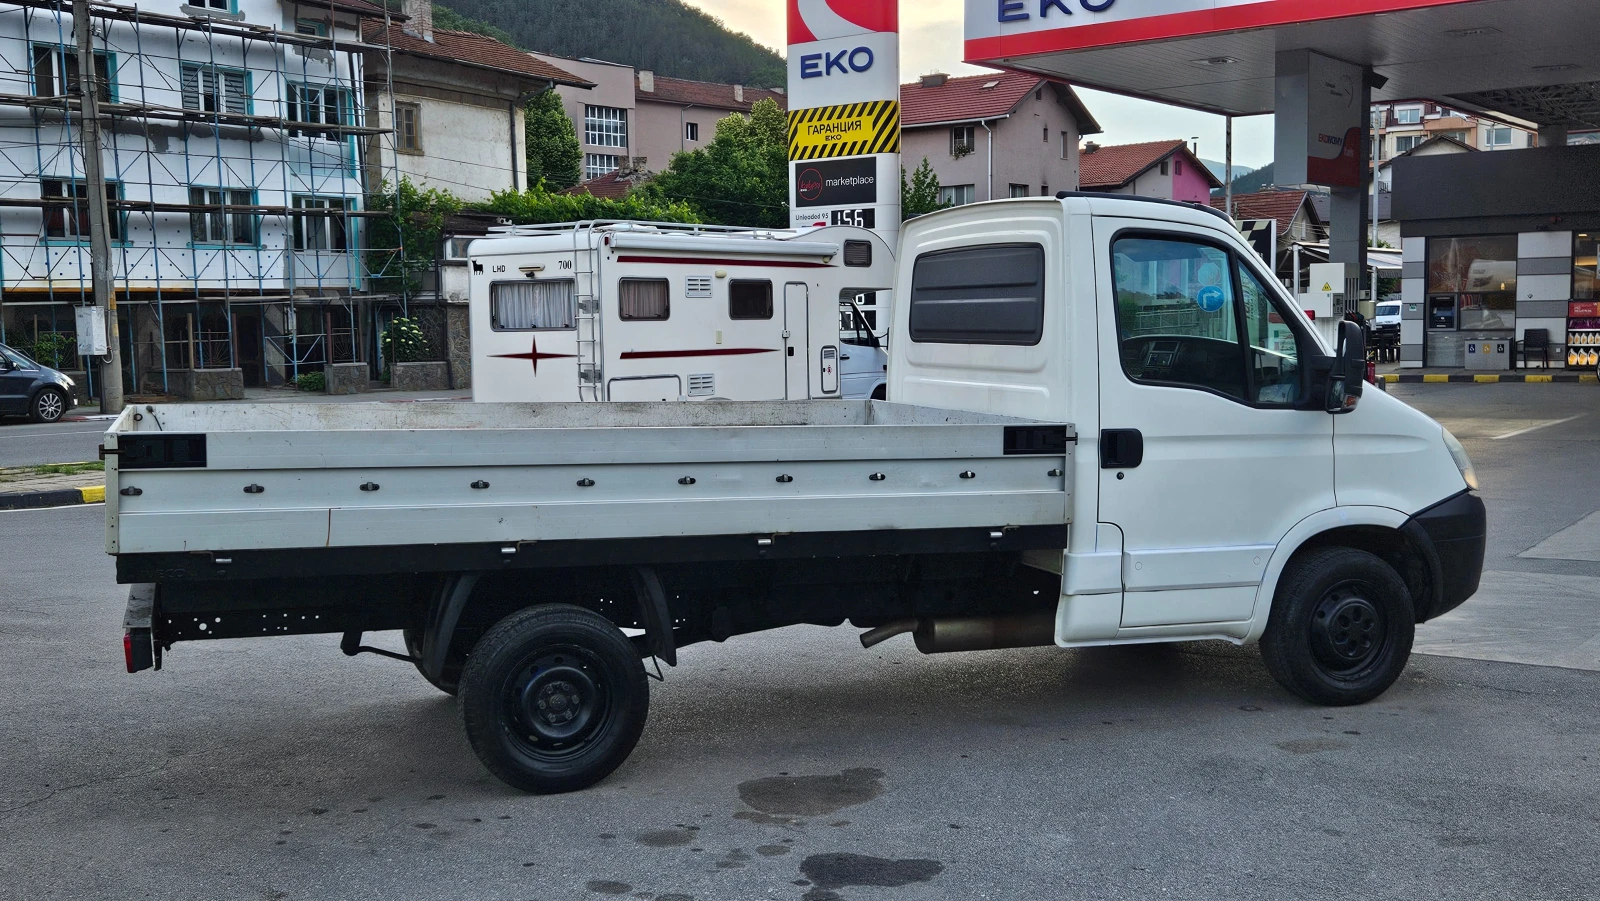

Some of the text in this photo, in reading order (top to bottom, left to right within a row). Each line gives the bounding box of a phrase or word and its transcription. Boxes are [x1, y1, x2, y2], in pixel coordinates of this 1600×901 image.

[801, 46, 874, 79] EKO
[807, 120, 862, 136] ГАРАНЦИЯ
[825, 175, 874, 187] marketplace
[795, 212, 821, 221] Unleaded
[492, 265, 506, 273] LHD
[558, 260, 572, 270] 700
